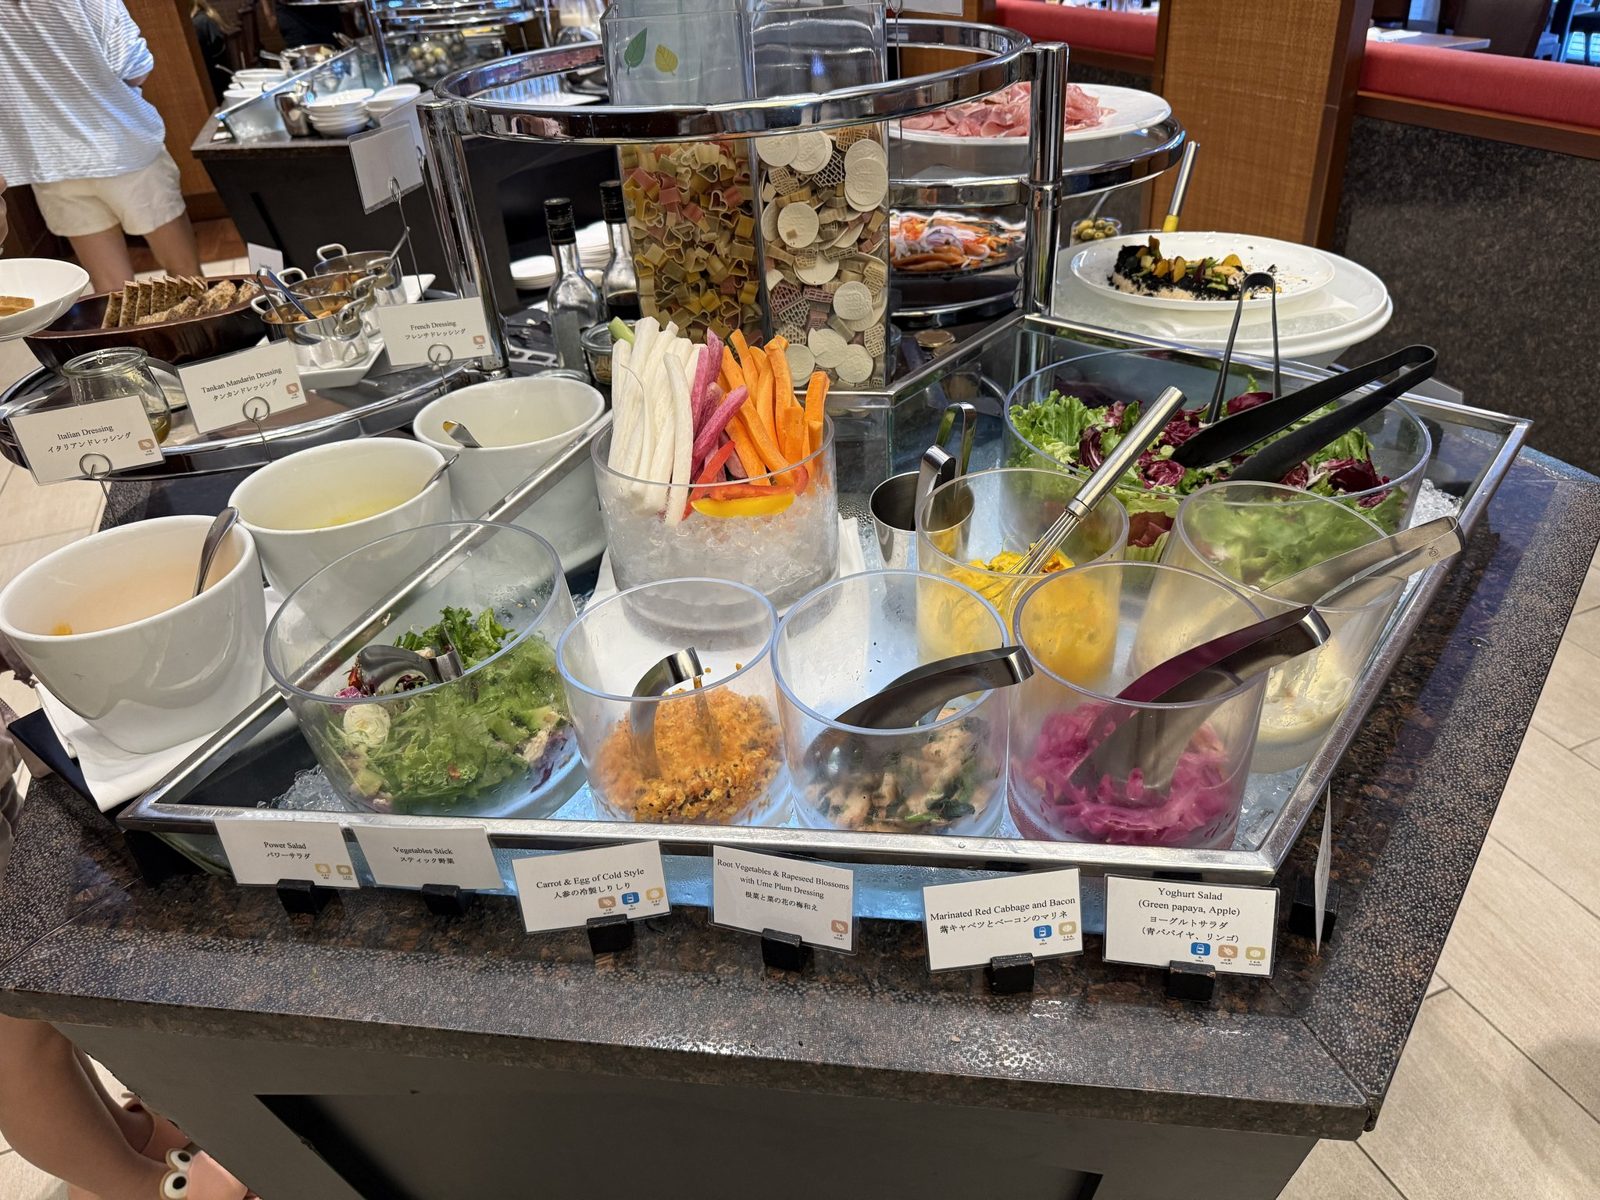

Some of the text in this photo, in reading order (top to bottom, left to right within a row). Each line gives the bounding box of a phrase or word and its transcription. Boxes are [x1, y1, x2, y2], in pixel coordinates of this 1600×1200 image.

[410, 320, 456, 331] French Dressing
[405, 328, 466, 340] フレンチドレッシング
[201, 368, 282, 394] Tankan Mandarin Dressing
[213, 378, 278, 401] タンカンドレッシング
[57, 425, 114, 441] Italian Dressing
[48, 431, 131, 453] イタリアンドレッシング
[263, 841, 307, 850] Power Salad
[393, 846, 453, 855] Vegetables Stick
[266, 851, 311, 860] パワーサラダ
[400, 856, 455, 865] スティック野菜
[536, 868, 645, 889] Carrot & Egg of Cold Style
[717, 858, 850, 890] Root Vegetables & Rapeseed Blossoms
[740, 875, 825, 899] with Ume Plum Dressing
[1158, 887, 1223, 901] Yoghurt Salad
[930, 897, 1076, 921] Marinated Red Cabbage and Bacon
[1138, 899, 1241, 917] (Green papaya, Apple)
[1150, 916, 1229, 930] ヨーグルトサラダ
